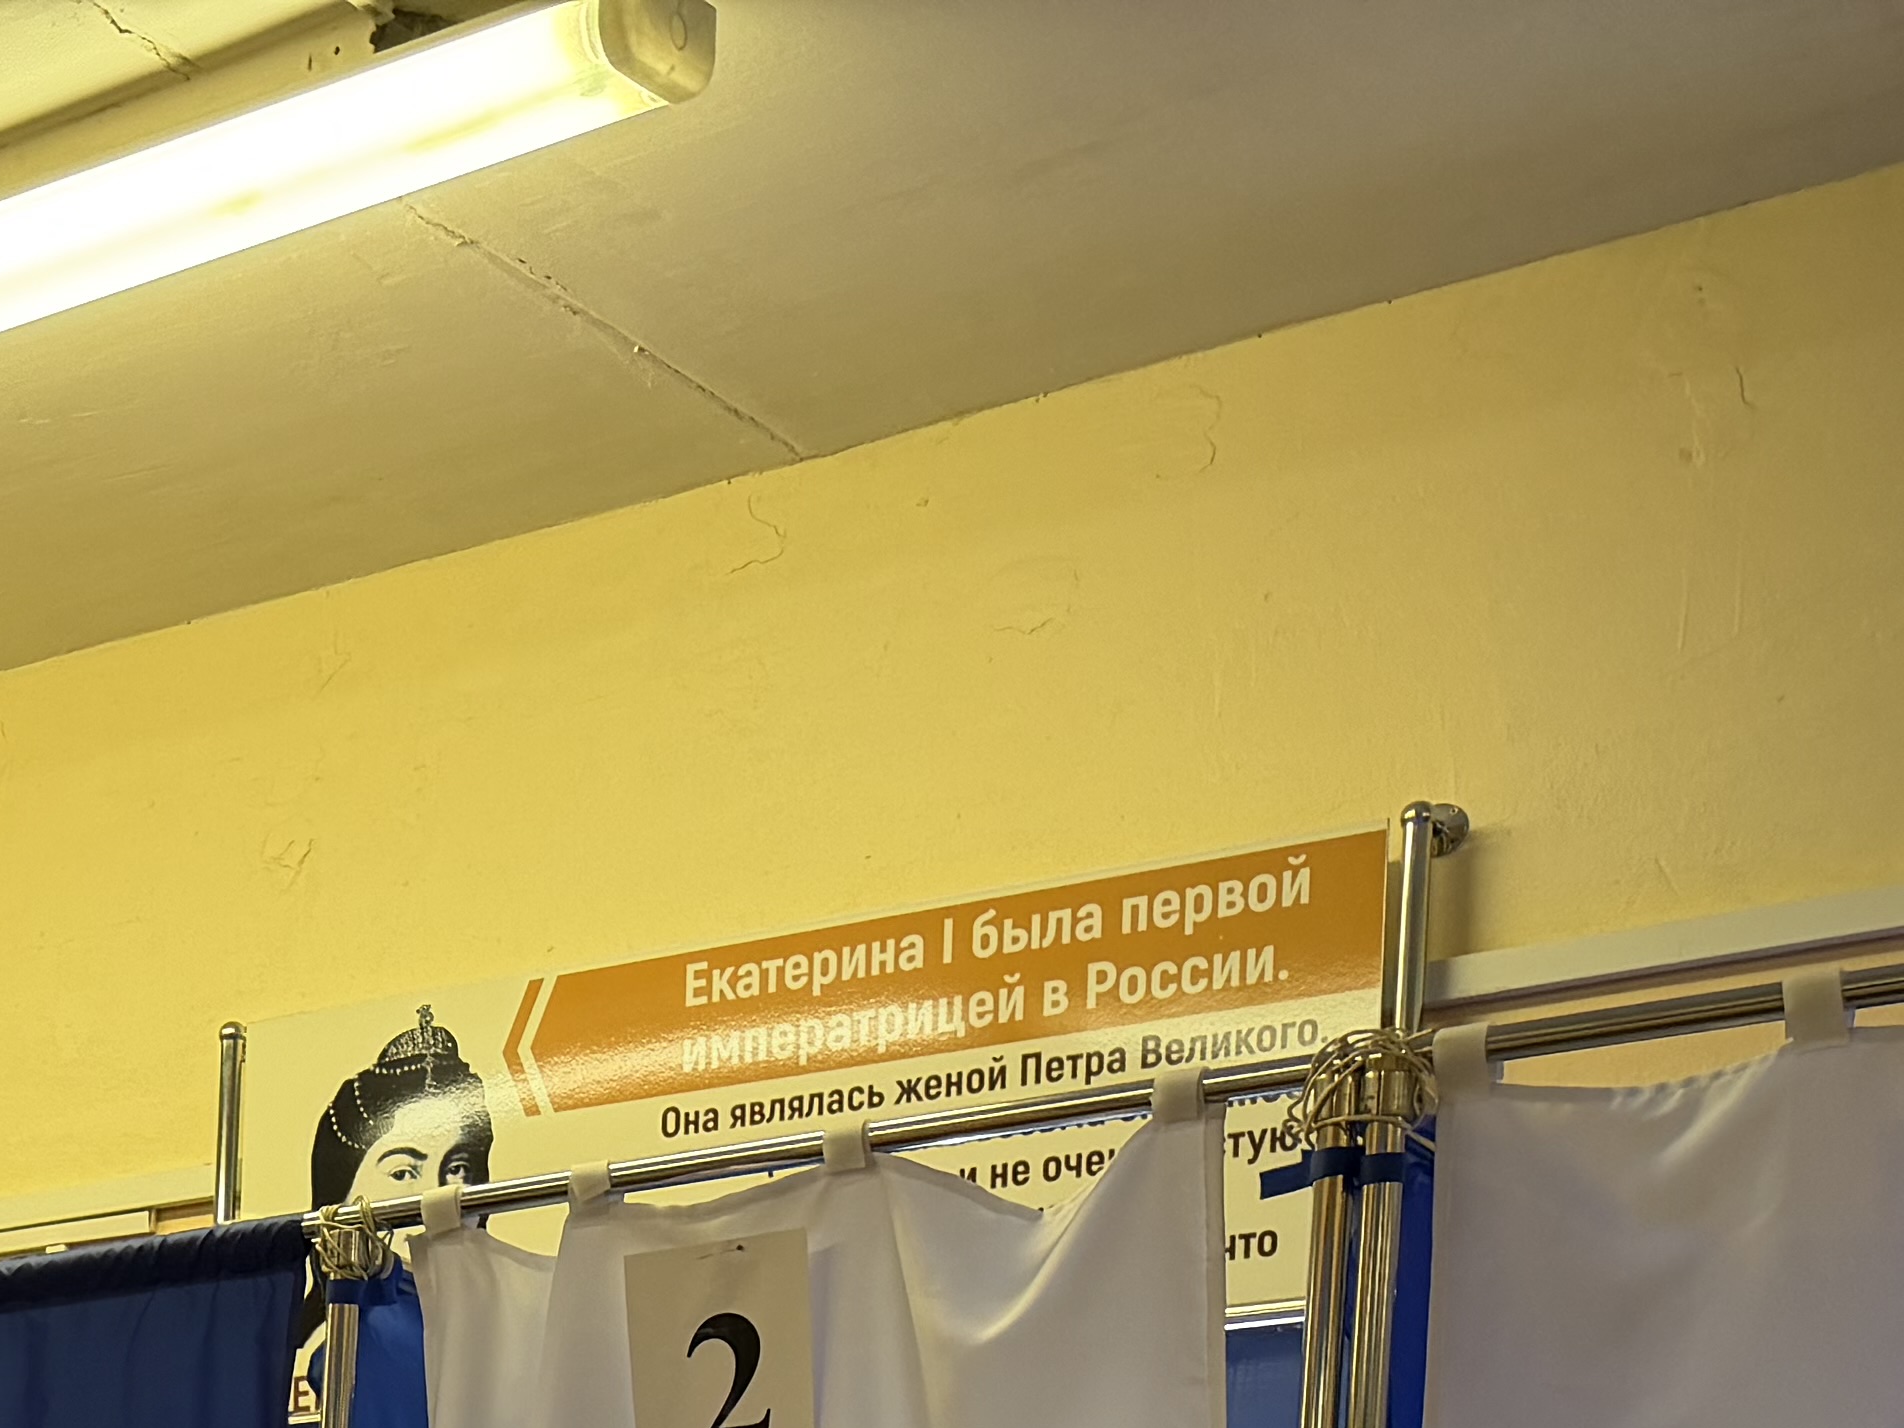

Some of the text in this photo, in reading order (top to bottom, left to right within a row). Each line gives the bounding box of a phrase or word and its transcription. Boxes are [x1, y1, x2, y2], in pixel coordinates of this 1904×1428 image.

[685, 932, 924, 1008] Екатерина
[972, 903, 1103, 959] была
[1121, 854, 1310, 936] первой
[681, 944, 1289, 1073] императрицей в России.
[661, 1105, 719, 1139] Она
[729, 1083, 885, 1129] являлась
[894, 1054, 1007, 1106] женой
[1020, 1047, 1126, 1087] Петра
[1140, 1018, 1328, 1070] Великого.
[990, 1159, 1030, 1189] не
[1042, 1148, 1116, 1183] оче
[1223, 1126, 1299, 1166] тую
